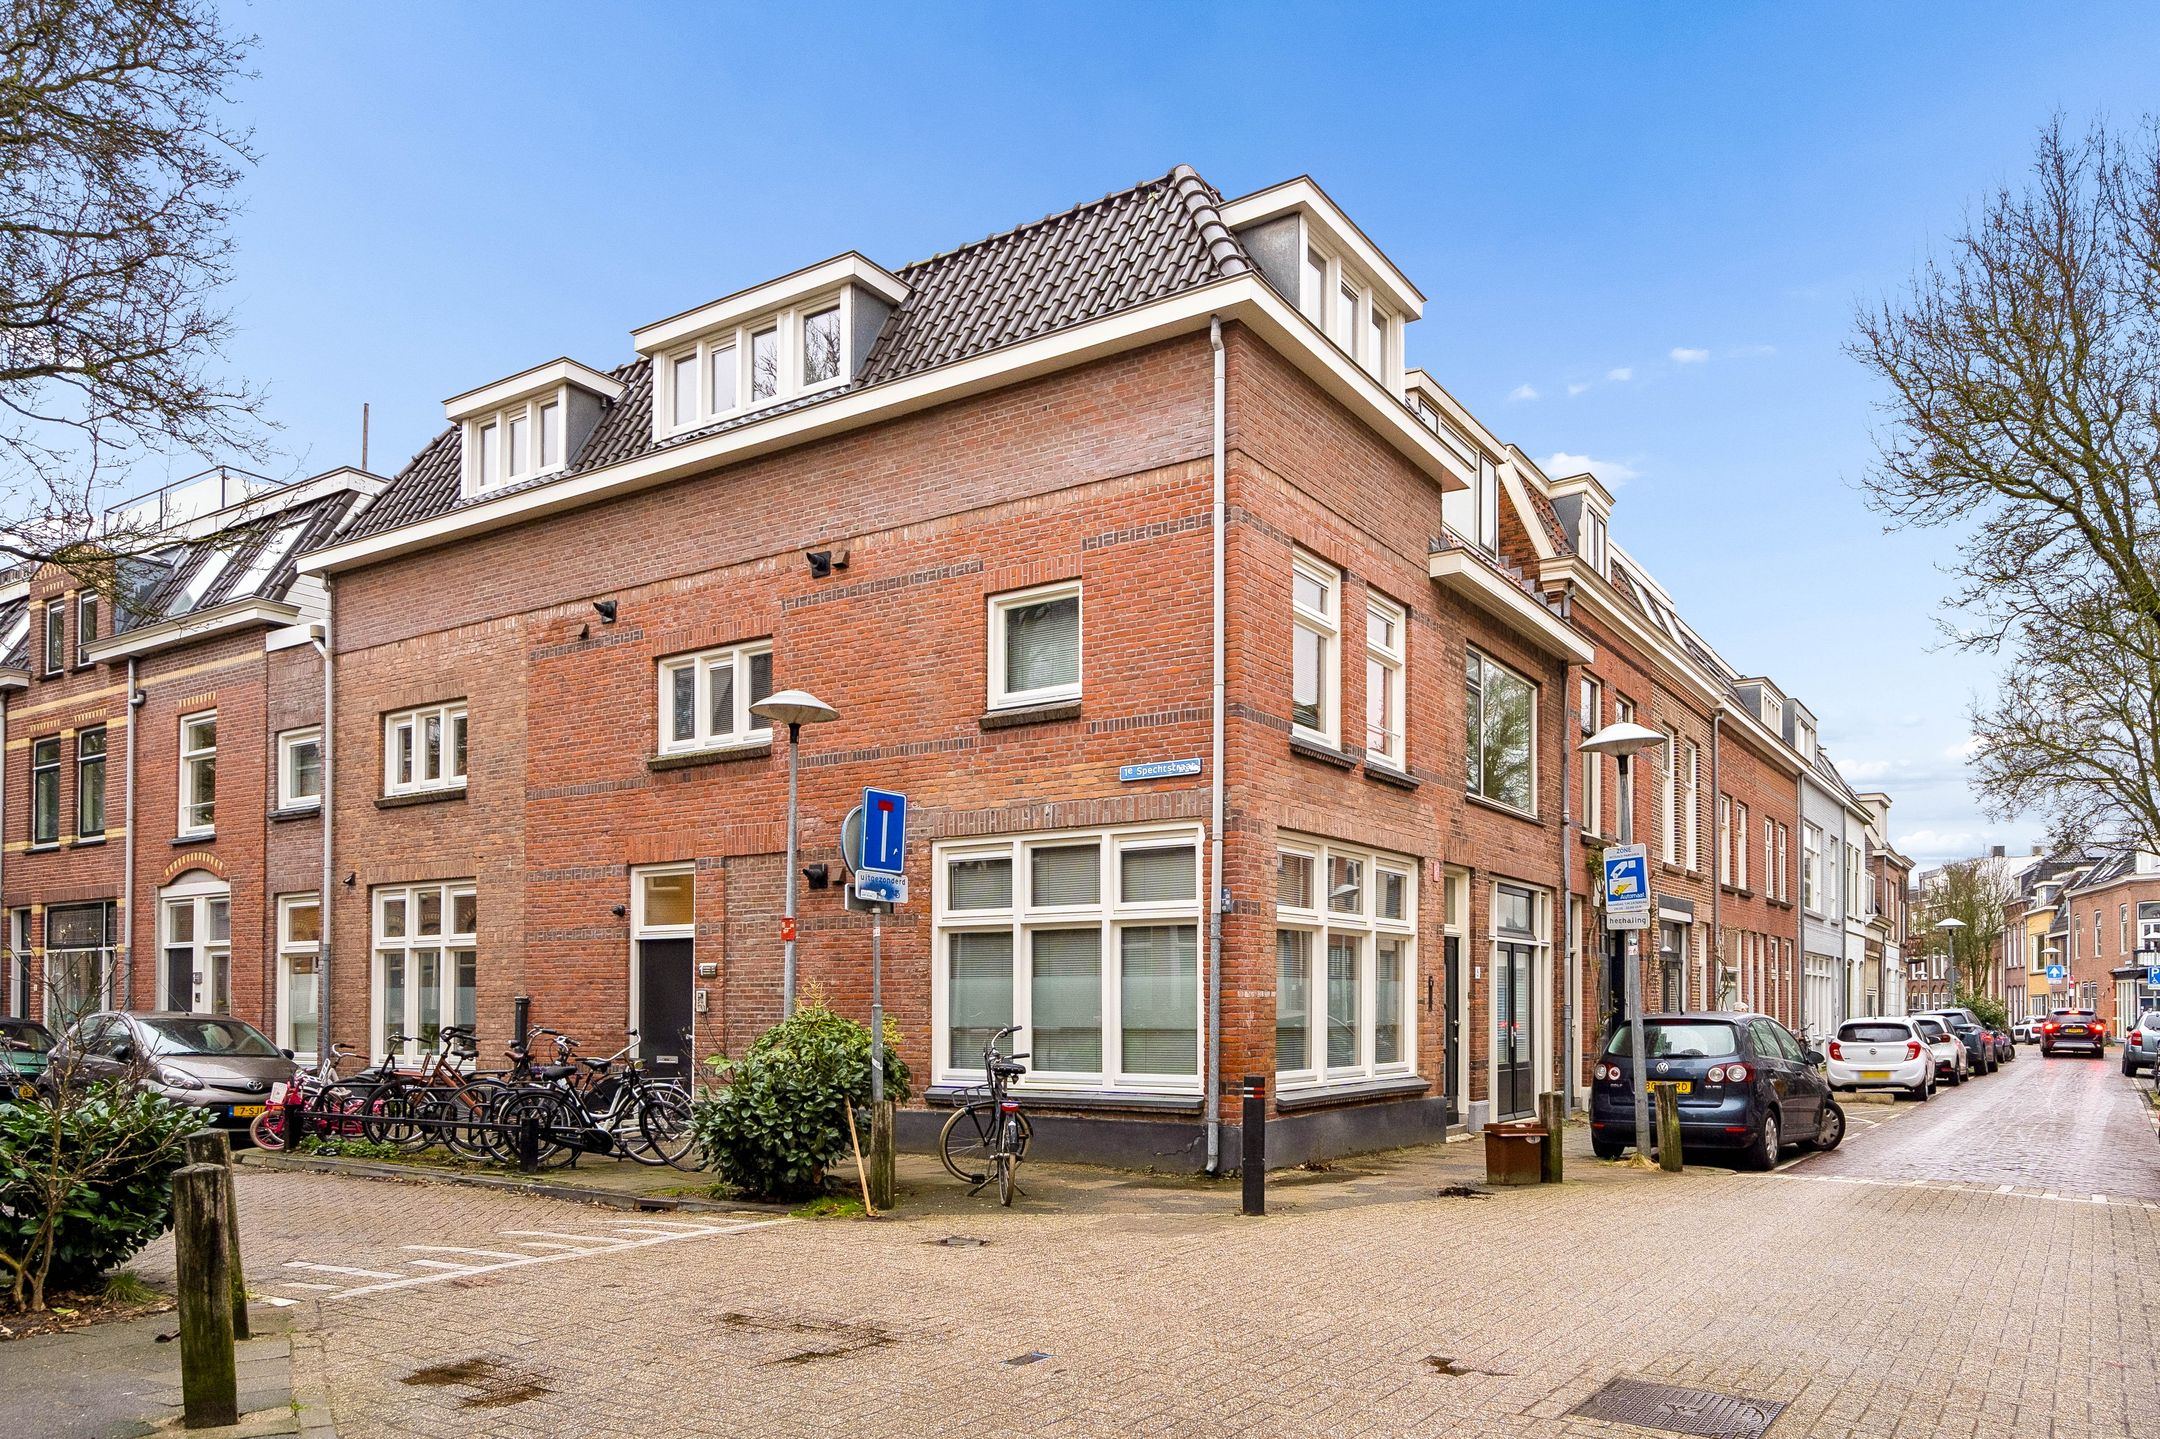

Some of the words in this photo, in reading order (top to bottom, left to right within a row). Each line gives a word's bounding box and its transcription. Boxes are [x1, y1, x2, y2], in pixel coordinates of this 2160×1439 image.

[860, 874, 906, 886] uitgezonderd
[1620, 892, 1646, 900] Automaat
[1609, 917, 1647, 925] herhaling
[2151, 968, 2160, 977] P
